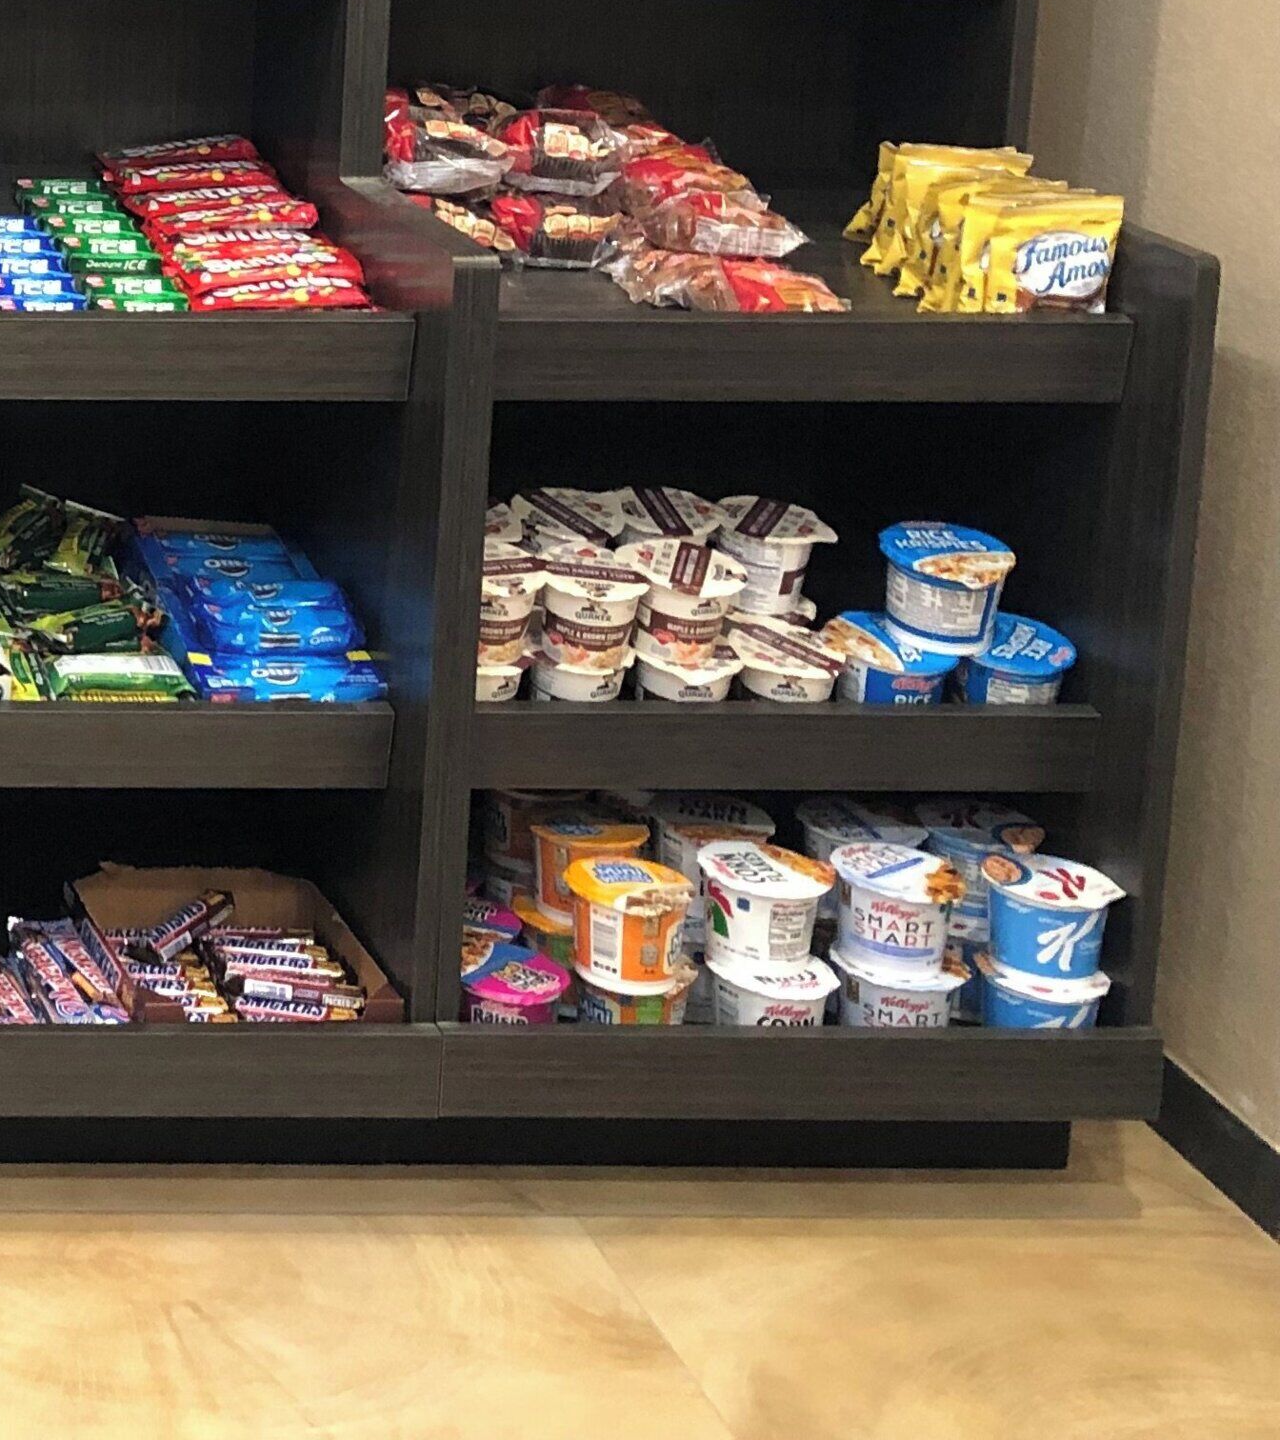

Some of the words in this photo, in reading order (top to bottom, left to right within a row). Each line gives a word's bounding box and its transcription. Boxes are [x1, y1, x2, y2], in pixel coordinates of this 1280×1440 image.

[123, 259, 148, 271] ICE
[1020, 235, 1109, 274] Famous
[895, 538, 988, 551] KRISPIES
[906, 529, 957, 540] RICE
[575, 611, 612, 622] QUAKER
[854, 907, 934, 934] SMART
[854, 923, 934, 948] START
[239, 996, 326, 1018] SNICKERS
[863, 1003, 940, 1026] SMART
